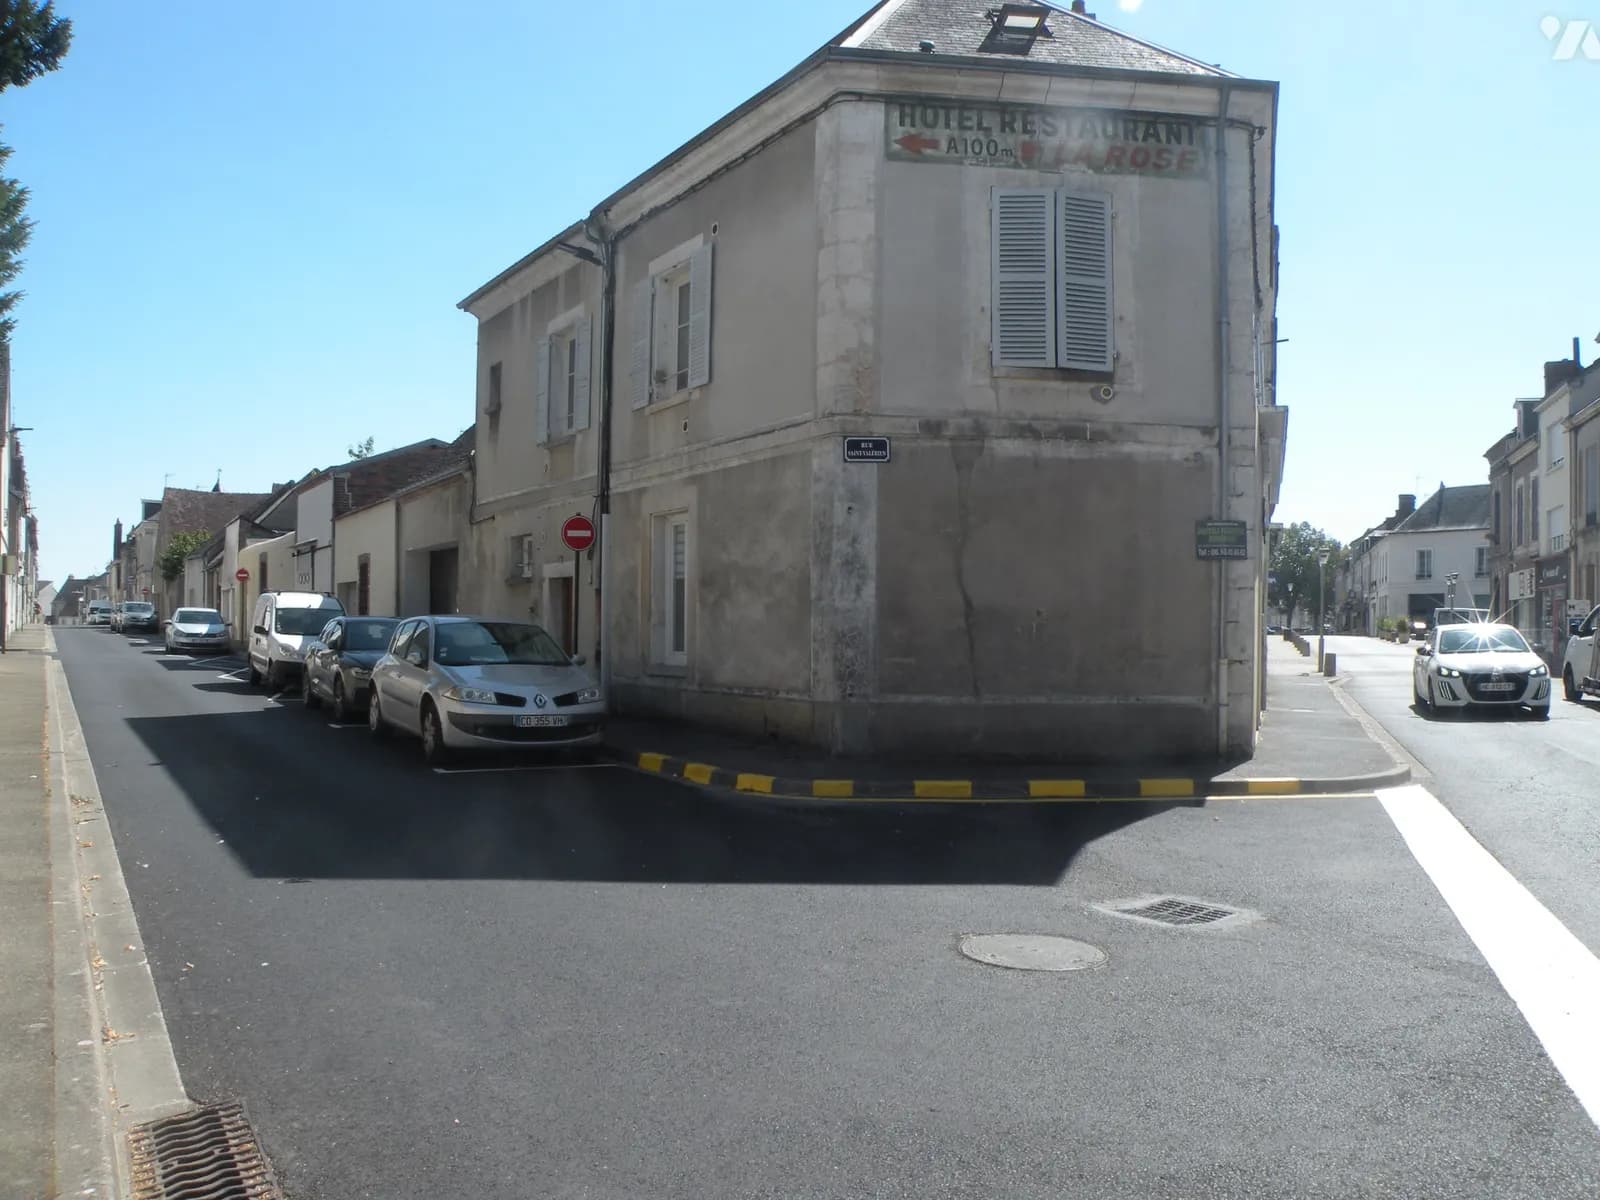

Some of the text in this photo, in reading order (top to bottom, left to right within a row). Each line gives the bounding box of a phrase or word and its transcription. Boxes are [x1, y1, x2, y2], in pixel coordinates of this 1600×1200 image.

[899, 103, 1197, 146] HOTEL RESTAURANT
[1104, 146, 1199, 172] ROSE
